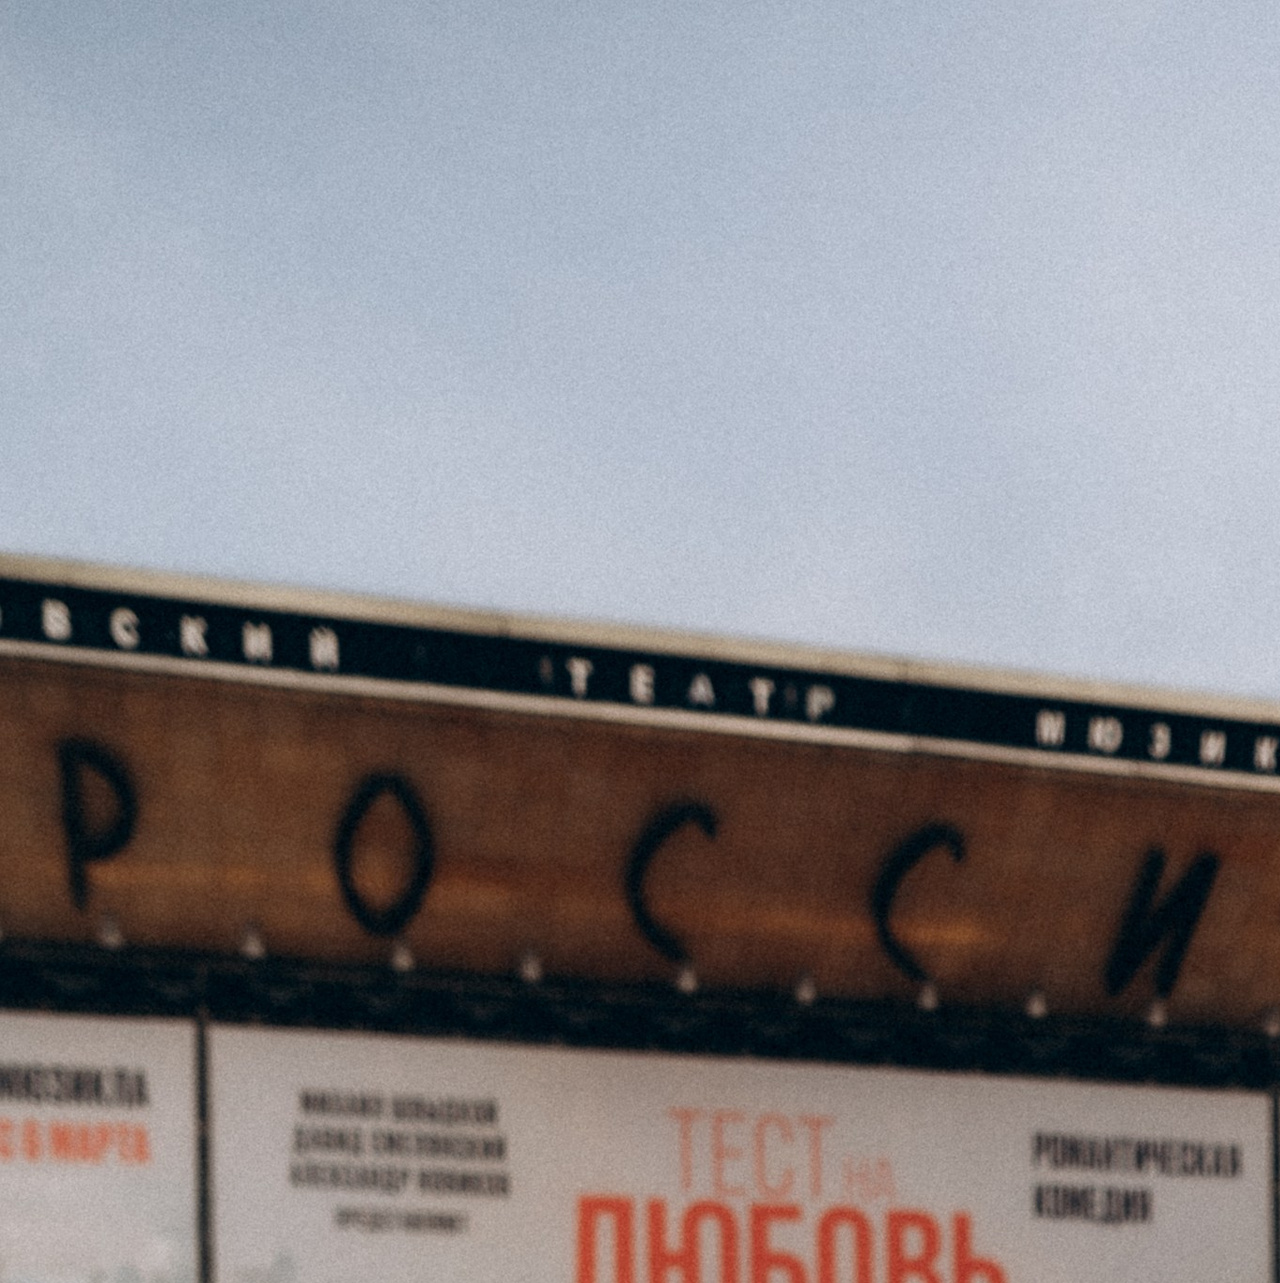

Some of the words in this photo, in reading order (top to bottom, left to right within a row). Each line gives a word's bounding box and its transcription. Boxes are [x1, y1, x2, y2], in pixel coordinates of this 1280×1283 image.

[0, 598, 341, 672] ВСКИЙ
[566, 656, 837, 722] ТЕАТР
[665, 1104, 838, 1198] ТЕСТ
[1033, 1131, 1242, 1178] РОМАНТИЧЕСКАЯ
[1033, 1184, 1152, 1225] КОМЕДИЯ
